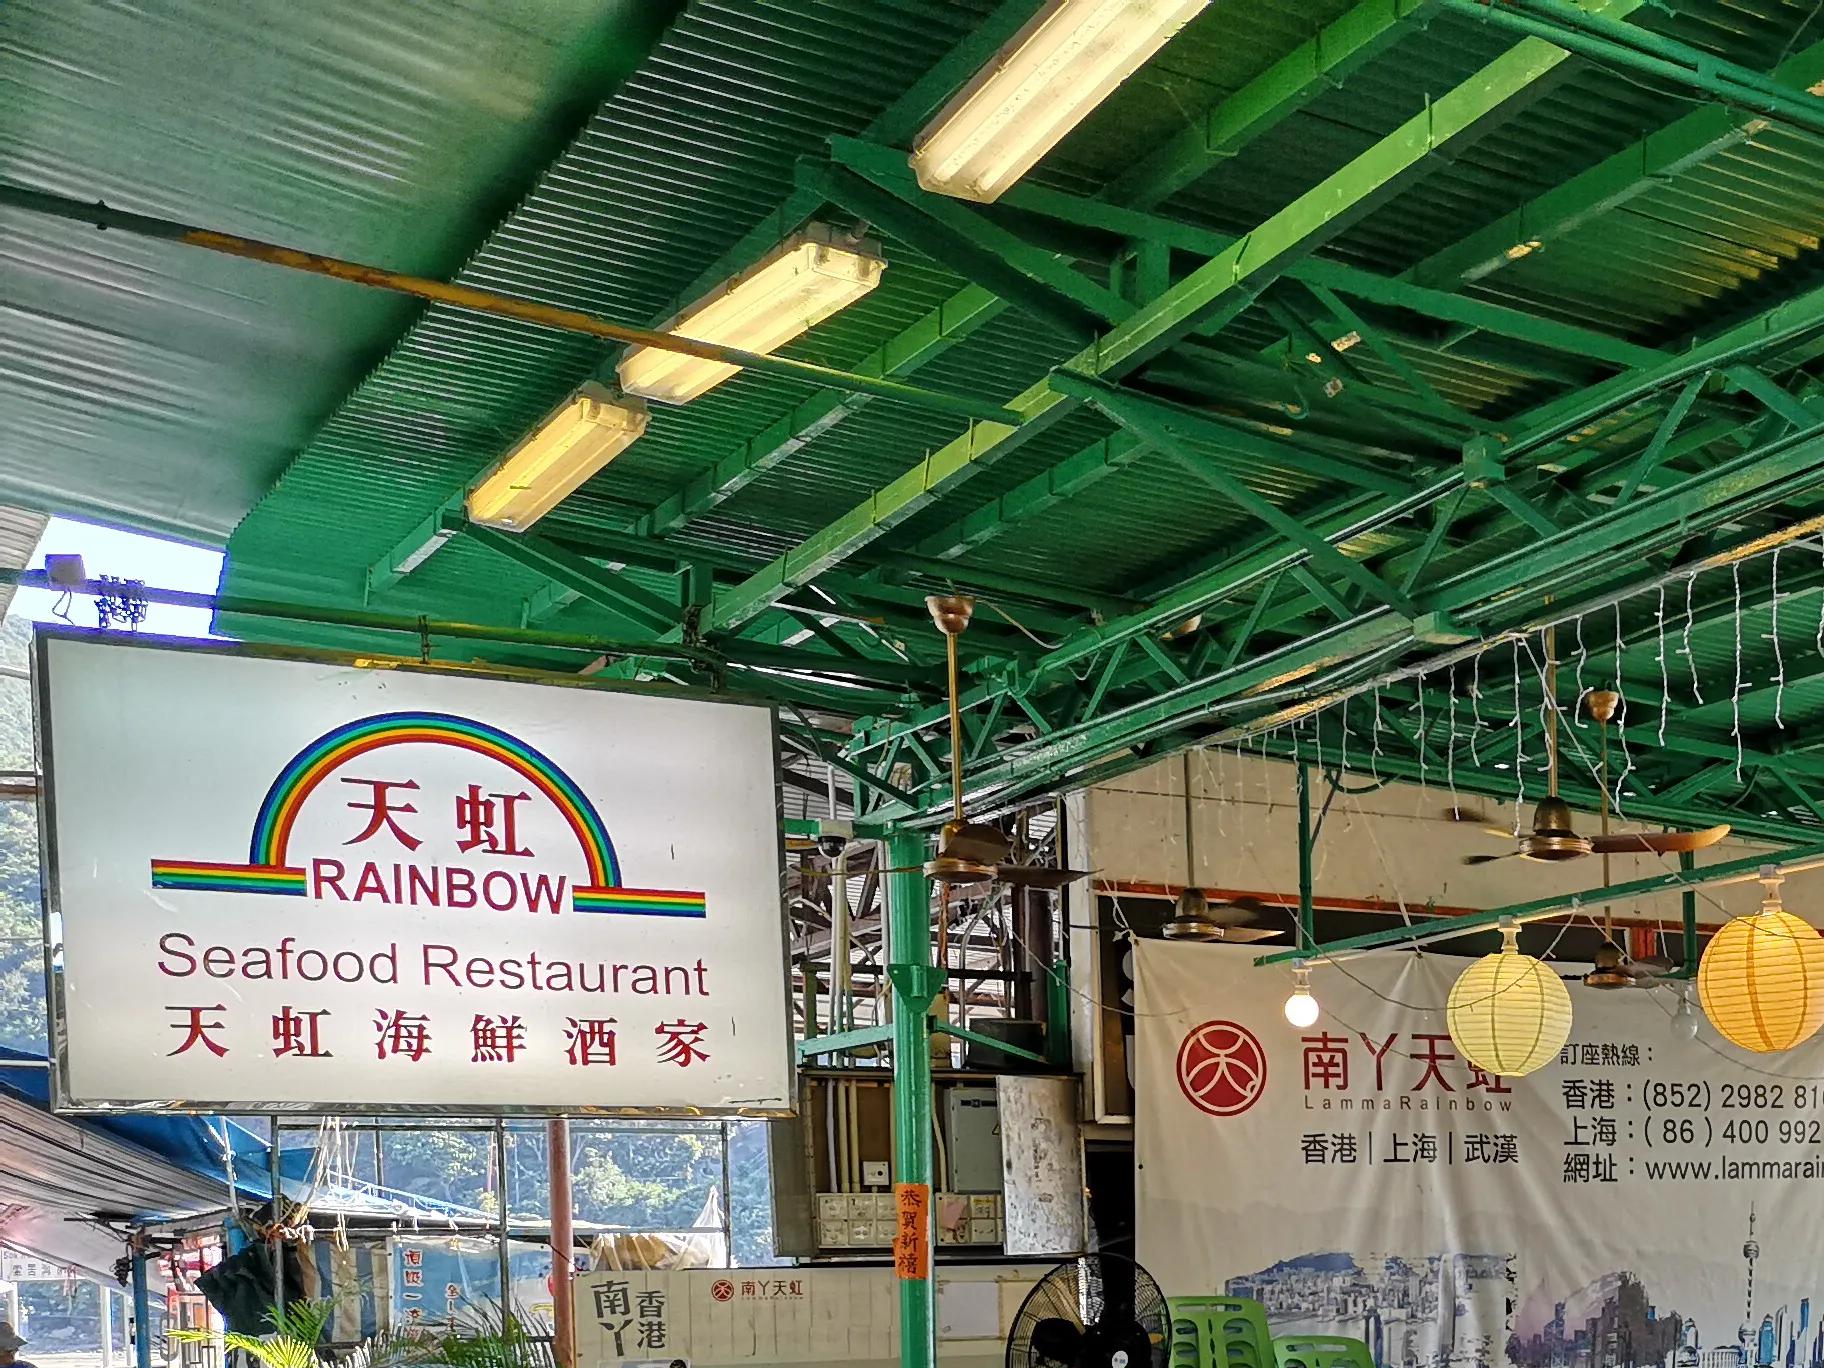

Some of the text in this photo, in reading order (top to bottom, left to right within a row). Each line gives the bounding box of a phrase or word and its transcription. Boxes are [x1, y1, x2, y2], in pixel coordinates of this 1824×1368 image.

[340, 777, 535, 860] 天虹
[312, 858, 567, 914] RAINBOW
[157, 932, 709, 997] Seafood Restaurant
[166, 1003, 711, 1068] 天虹海鮮酒家
[1721, 1084, 1784, 1109] 2982
[1722, 1119, 1769, 1144] 400
[1779, 1120, 1821, 1144] 992
[741, 1280, 803, 1296] 南丫天虹
